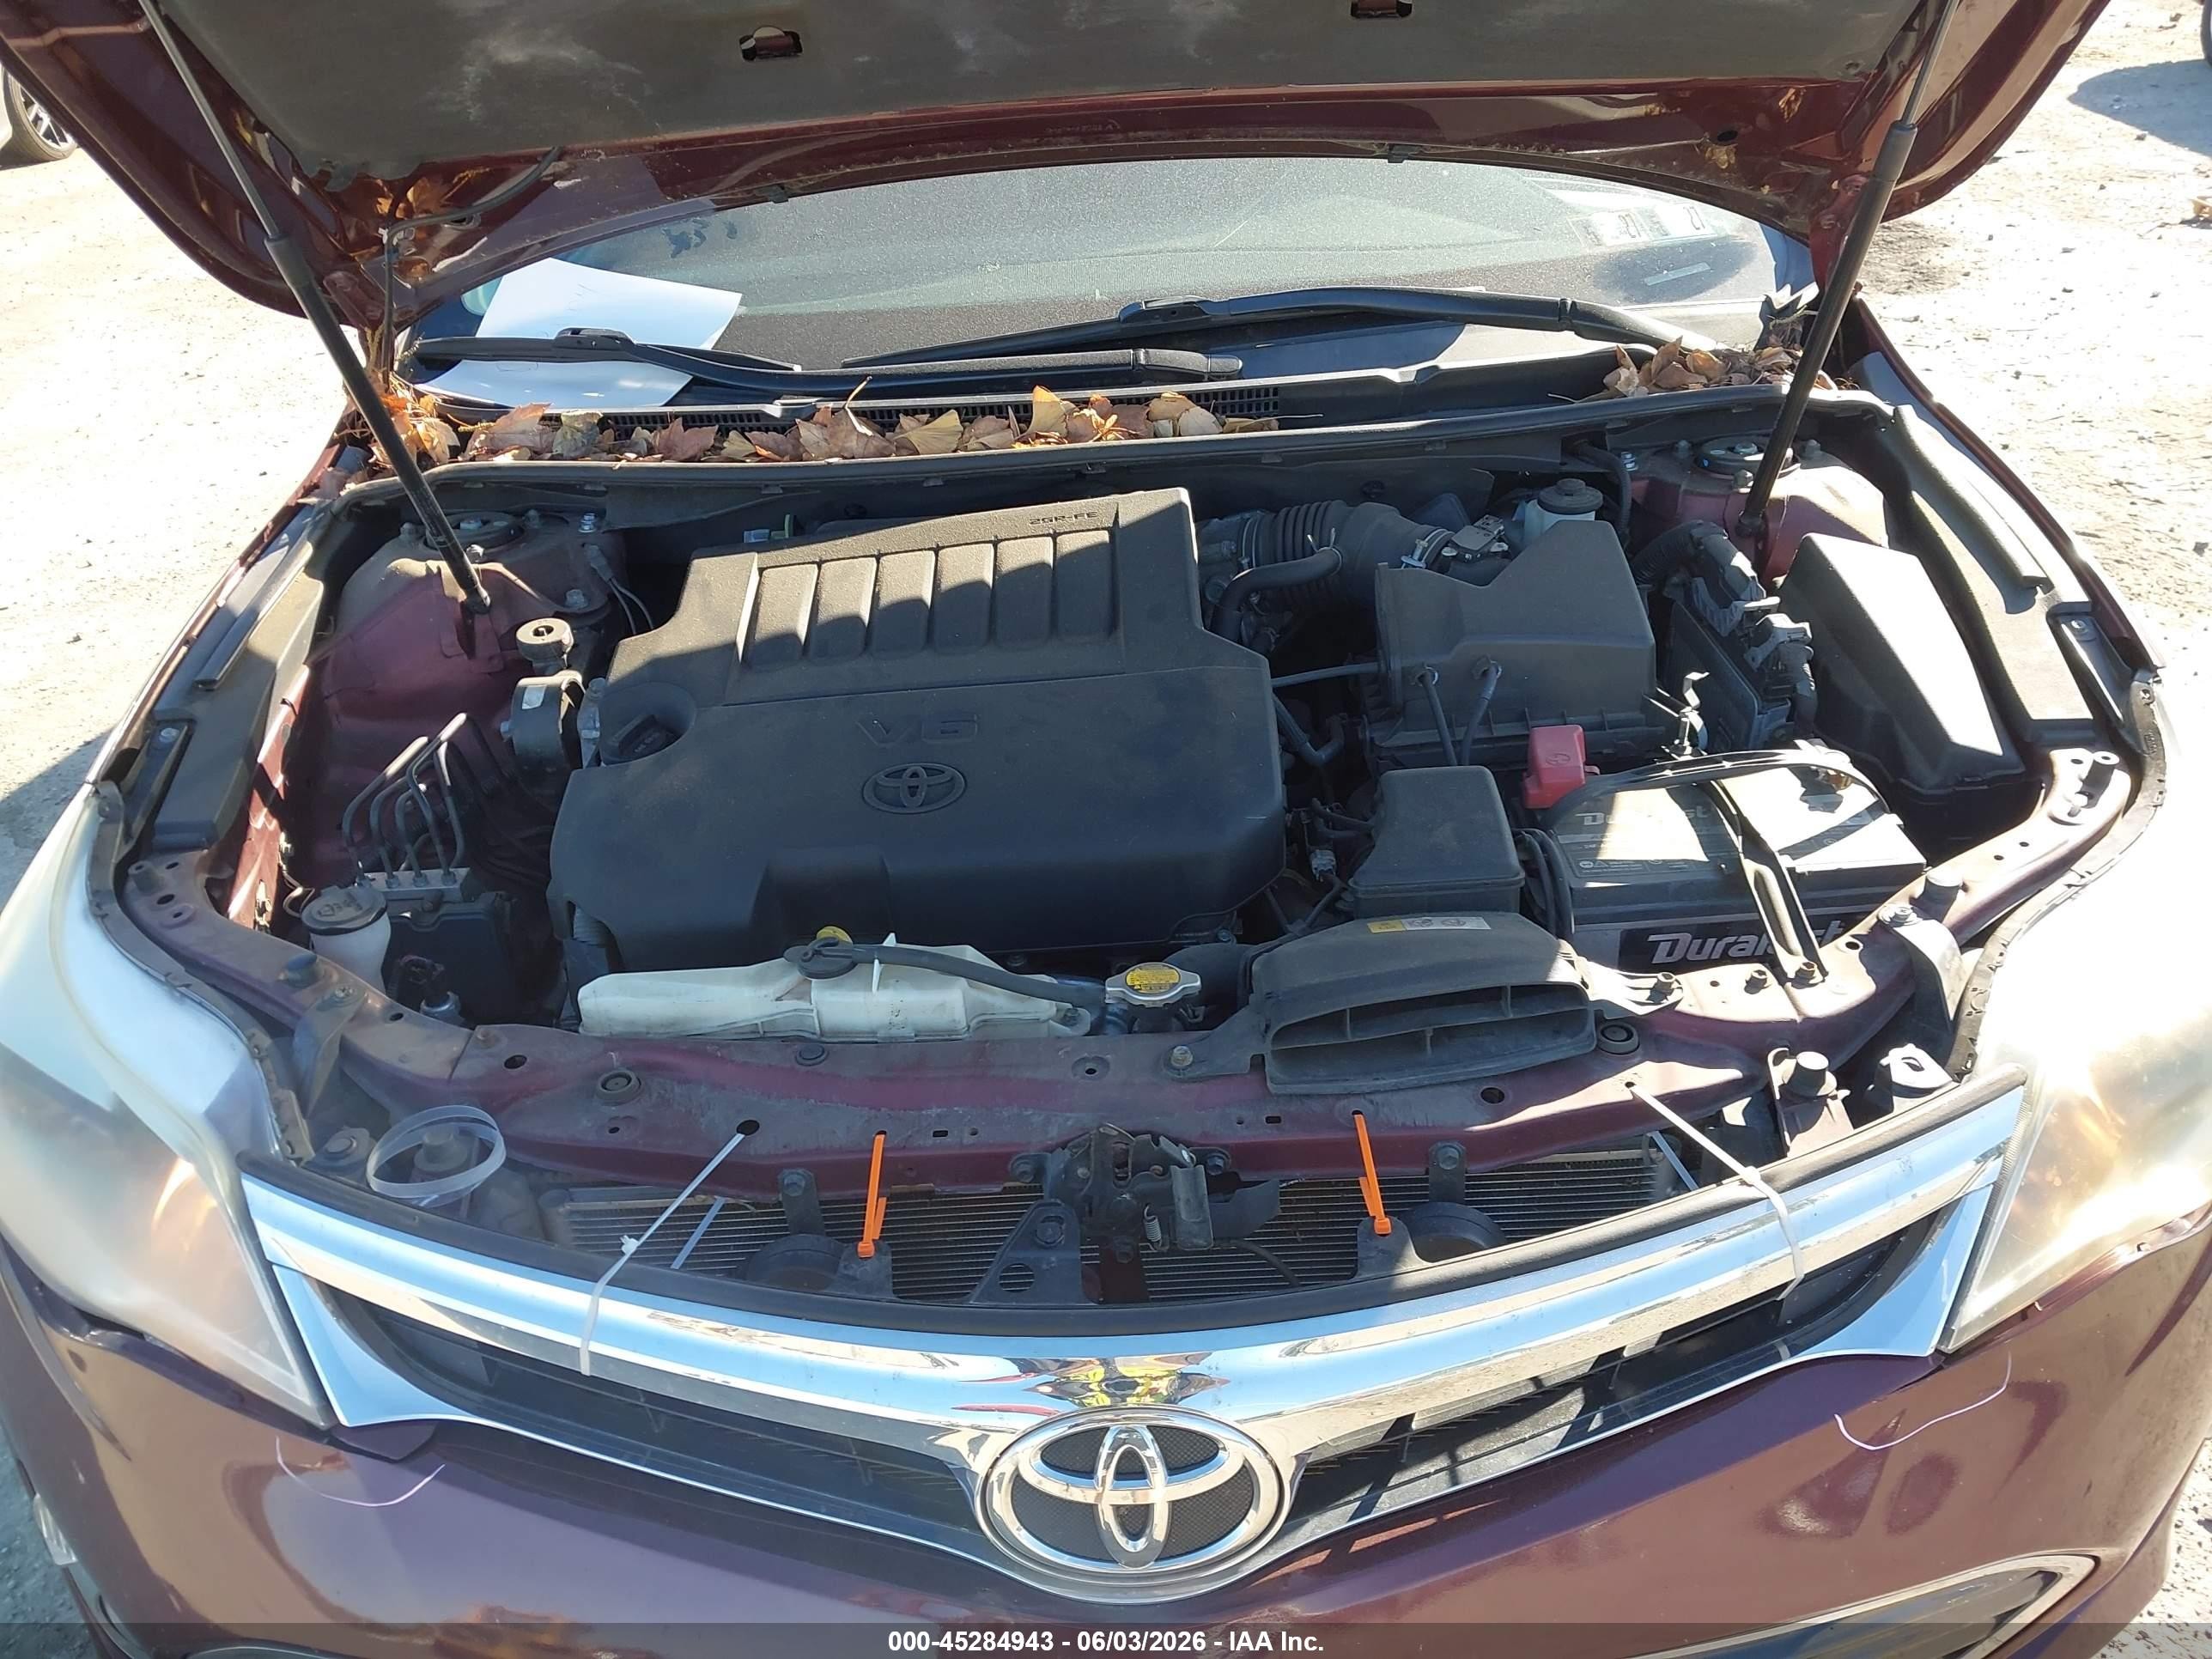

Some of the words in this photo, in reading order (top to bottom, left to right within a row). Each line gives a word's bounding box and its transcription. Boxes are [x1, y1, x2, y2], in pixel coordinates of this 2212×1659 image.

[1029, 511, 1097, 526] 2GR-FE
[854, 713, 978, 746] V6
[1647, 920, 1845, 964] Duralt
